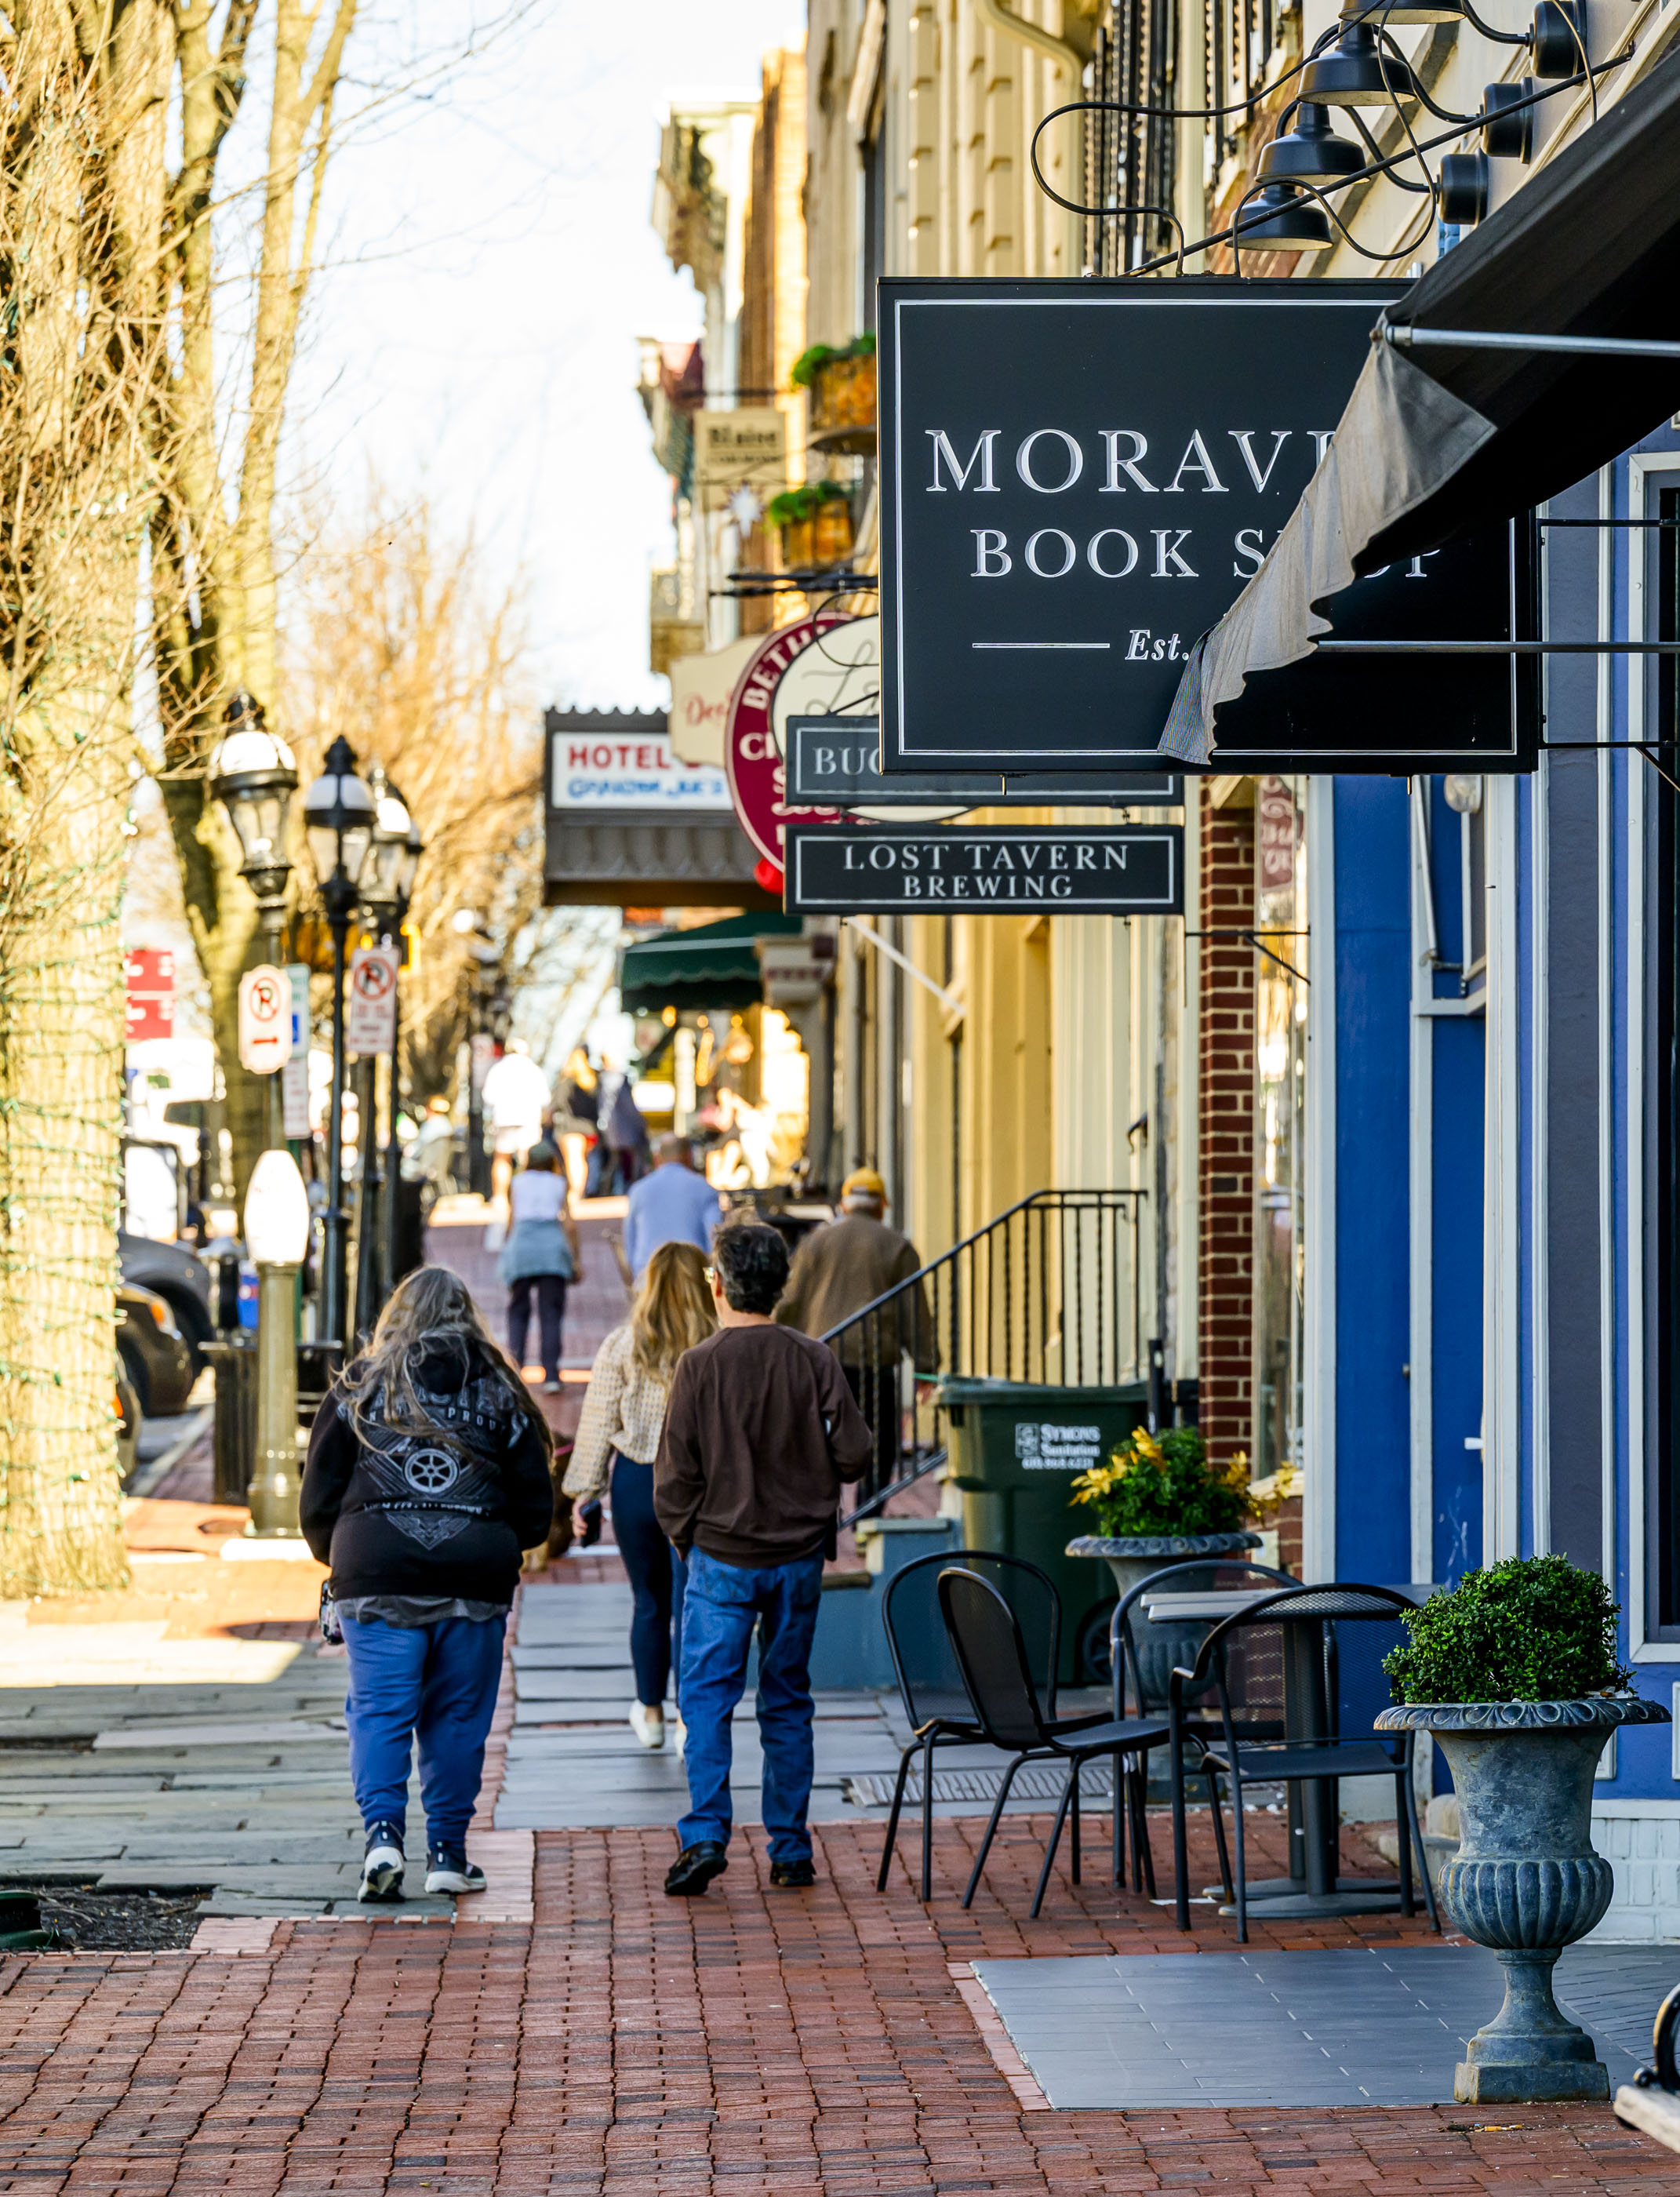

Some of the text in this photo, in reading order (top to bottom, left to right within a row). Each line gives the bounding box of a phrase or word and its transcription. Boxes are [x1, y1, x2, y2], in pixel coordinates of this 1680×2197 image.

[970, 528, 1199, 578] BOOK
[1125, 629, 1191, 661] Est.
[567, 744, 671, 769] HOTEL
[843, 843, 1129, 871] LOST TAVERN
[904, 875, 1074, 898] BREWING
